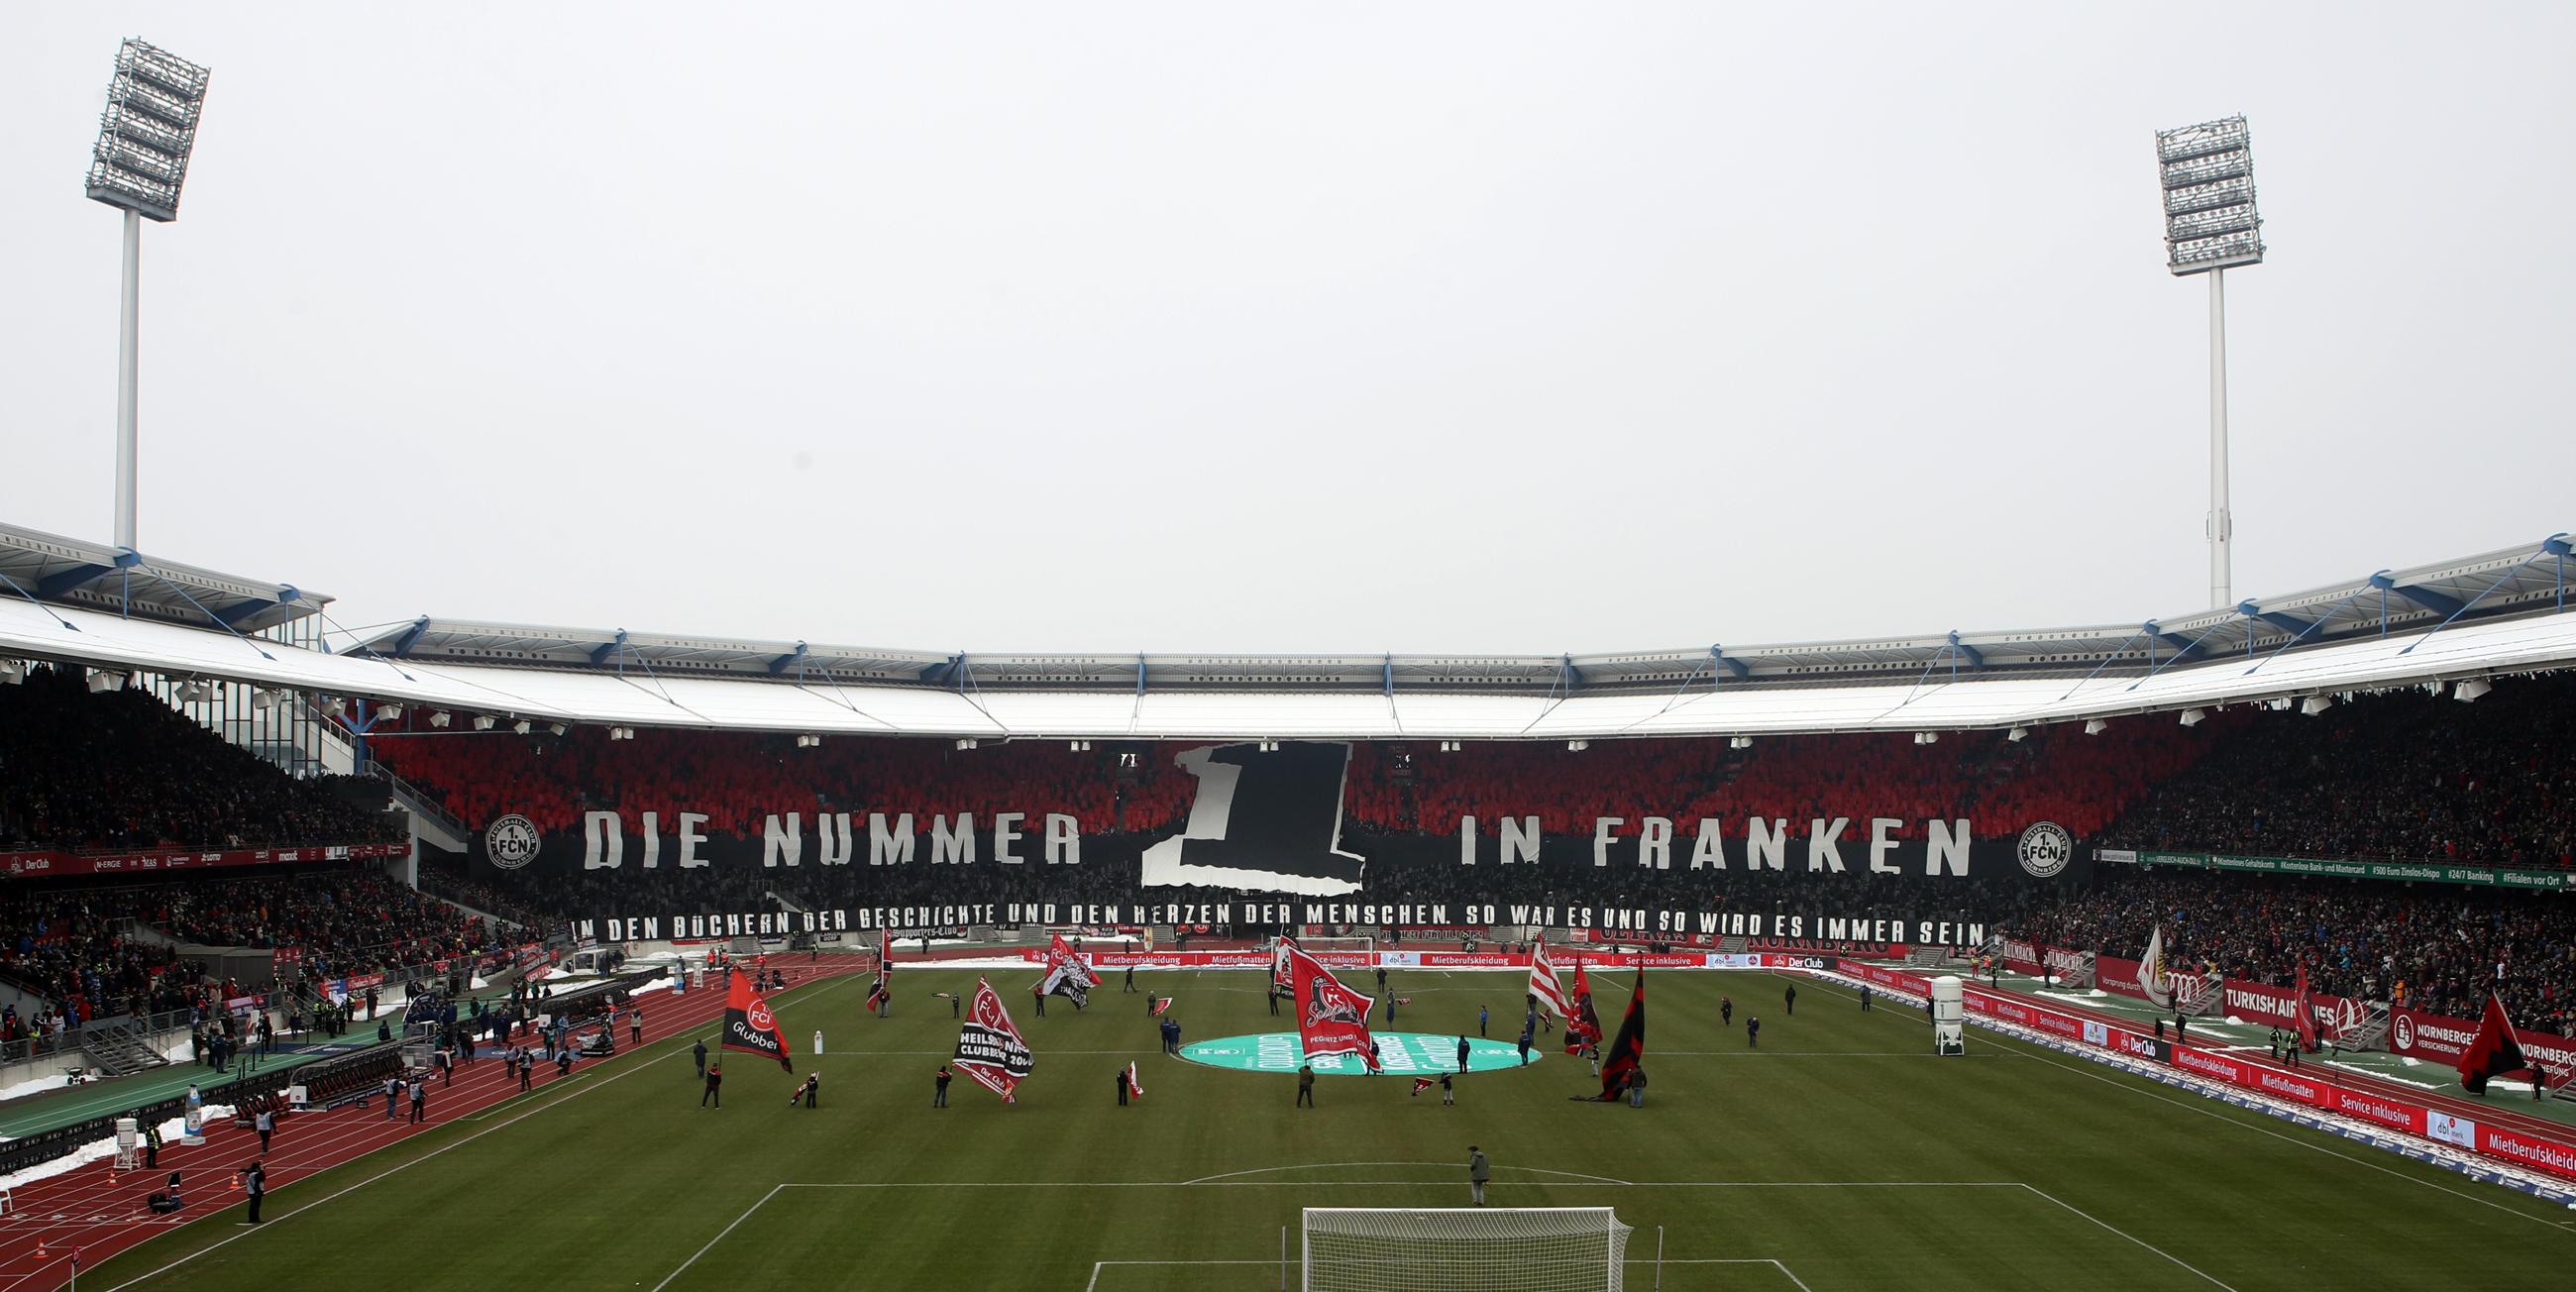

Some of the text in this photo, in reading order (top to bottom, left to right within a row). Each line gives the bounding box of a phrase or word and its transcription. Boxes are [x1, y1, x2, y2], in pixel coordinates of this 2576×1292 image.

[499, 839, 527, 853] FCN
[585, 811, 1080, 869] DIE NUMMER
[1461, 814, 1970, 876] IN FRANKEN
[2030, 846, 2058, 859] FCN
[2386, 867, 2401, 877] Euro
[2448, 870, 2494, 883] #24/7 Banking
[2503, 872, 2560, 887] #Filialen vor Ort
[607, 916, 658, 941] DEN
[674, 912, 790, 938] BÜCHERN
[804, 910, 846, 932] DER
[859, 904, 995, 928] GESCHICHTE
[1009, 904, 1056, 923] UND
[1071, 904, 1119, 924] DEN
[1134, 904, 1231, 924] HERZEN
[1245, 904, 1291, 923] DER
[1306, 904, 1451, 924] MENSCHEN.
[1466, 905, 1494, 924] SO
[1510, 905, 1555, 925] WAR
[1567, 907, 1591, 927] ES
[1603, 909, 1646, 930] UND
[1659, 911, 1685, 931] SO
[1699, 912, 1761, 935] WIRD
[1774, 915, 1802, 937] ES
[1817, 917, 1904, 942] IMMER
[1103, 954, 1180, 965] Mietberufskleidung
[1212, 955, 1271, 965] Mietfußmatten
[1330, 955, 1365, 964] inklusive
[1432, 955, 1509, 966] Mietberufskleidung
[1656, 956, 1691, 965] inklusive
[1788, 957, 1823, 968] Der Club
[2102, 976, 2140, 992] Vorsprung durch
[2226, 989, 2276, 1015] TURKISH
[2130, 1035, 2156, 1057] Der Club
[2417, 1039, 2461, 1055] VERSICHERUNG
[2178, 1052, 2237, 1080] Mietberufskleidung
[2262, 1073, 2314, 1099] Mietfußmatten
[2341, 1094, 2411, 1126] Service inklusive
[2437, 1121, 2449, 1135] dbl
